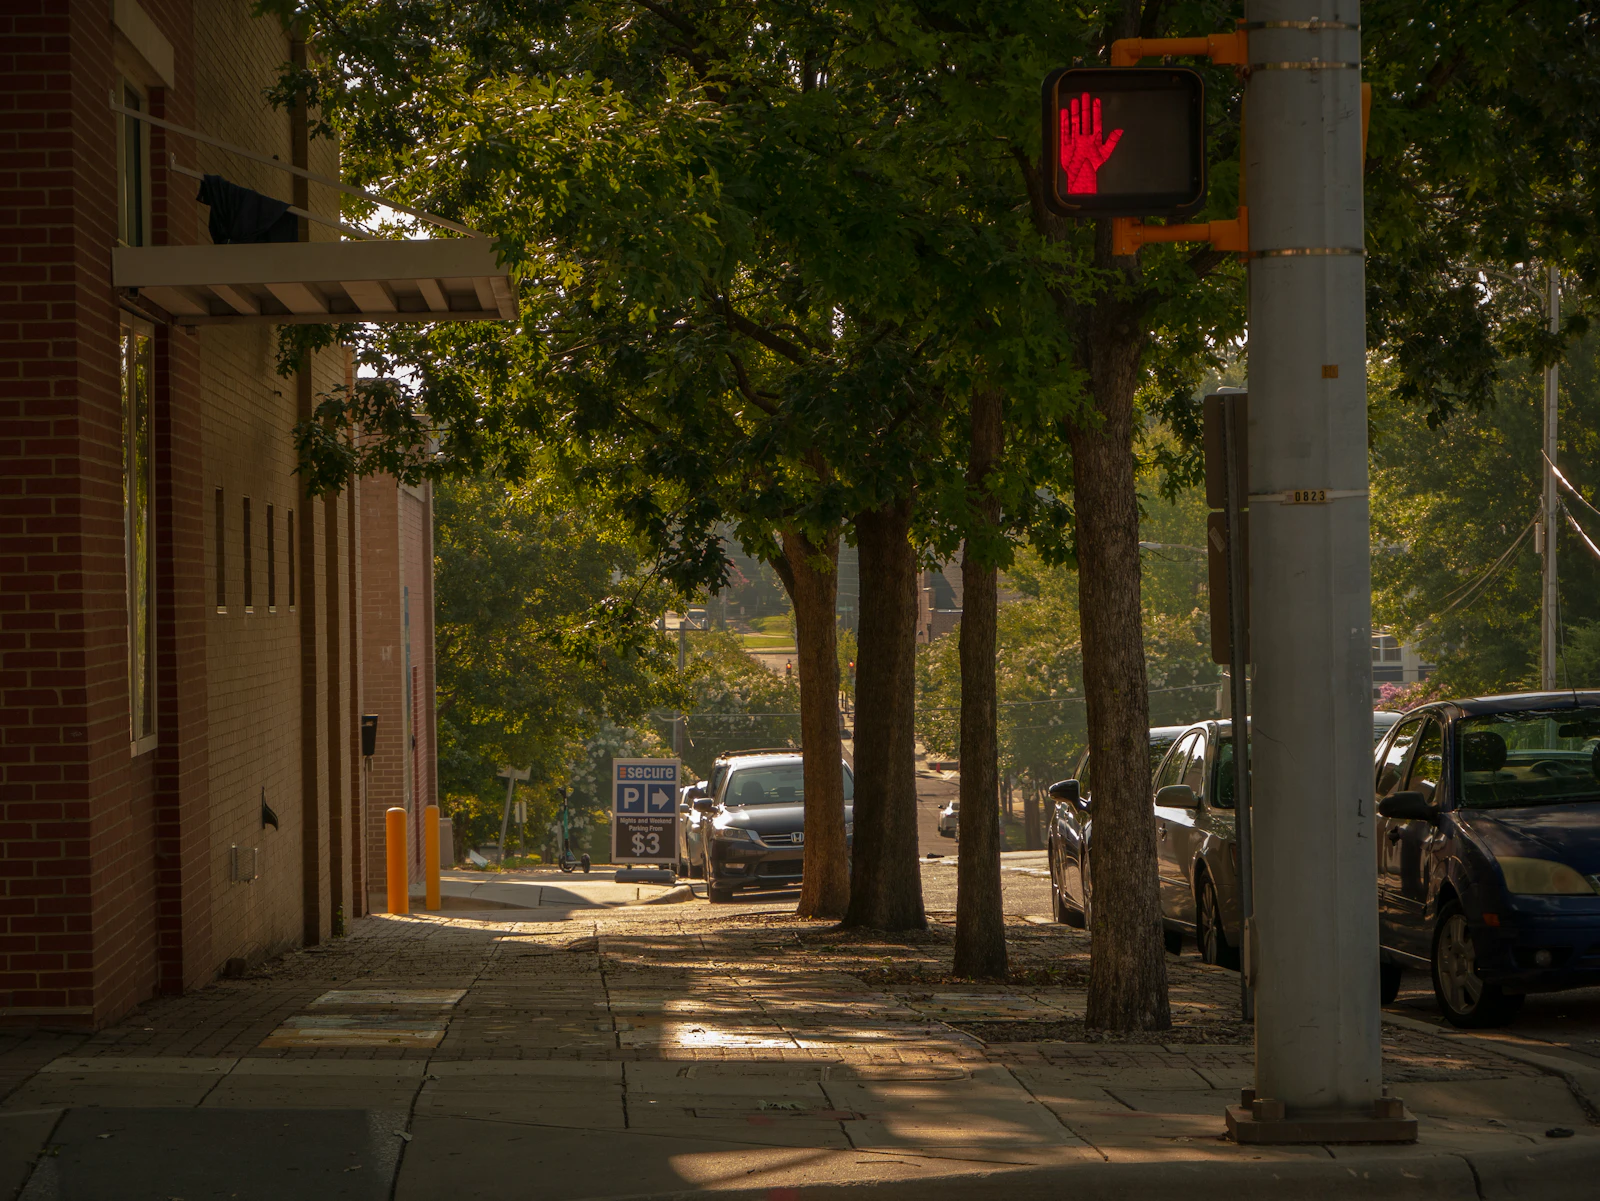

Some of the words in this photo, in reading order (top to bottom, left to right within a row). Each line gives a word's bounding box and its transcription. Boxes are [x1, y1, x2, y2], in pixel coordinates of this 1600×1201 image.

[1295, 491, 1325, 501] 0823
[627, 767, 674, 779] secure
[623, 787, 640, 809] P
[620, 817, 636, 825] Nights
[631, 832, 660, 857] $3
